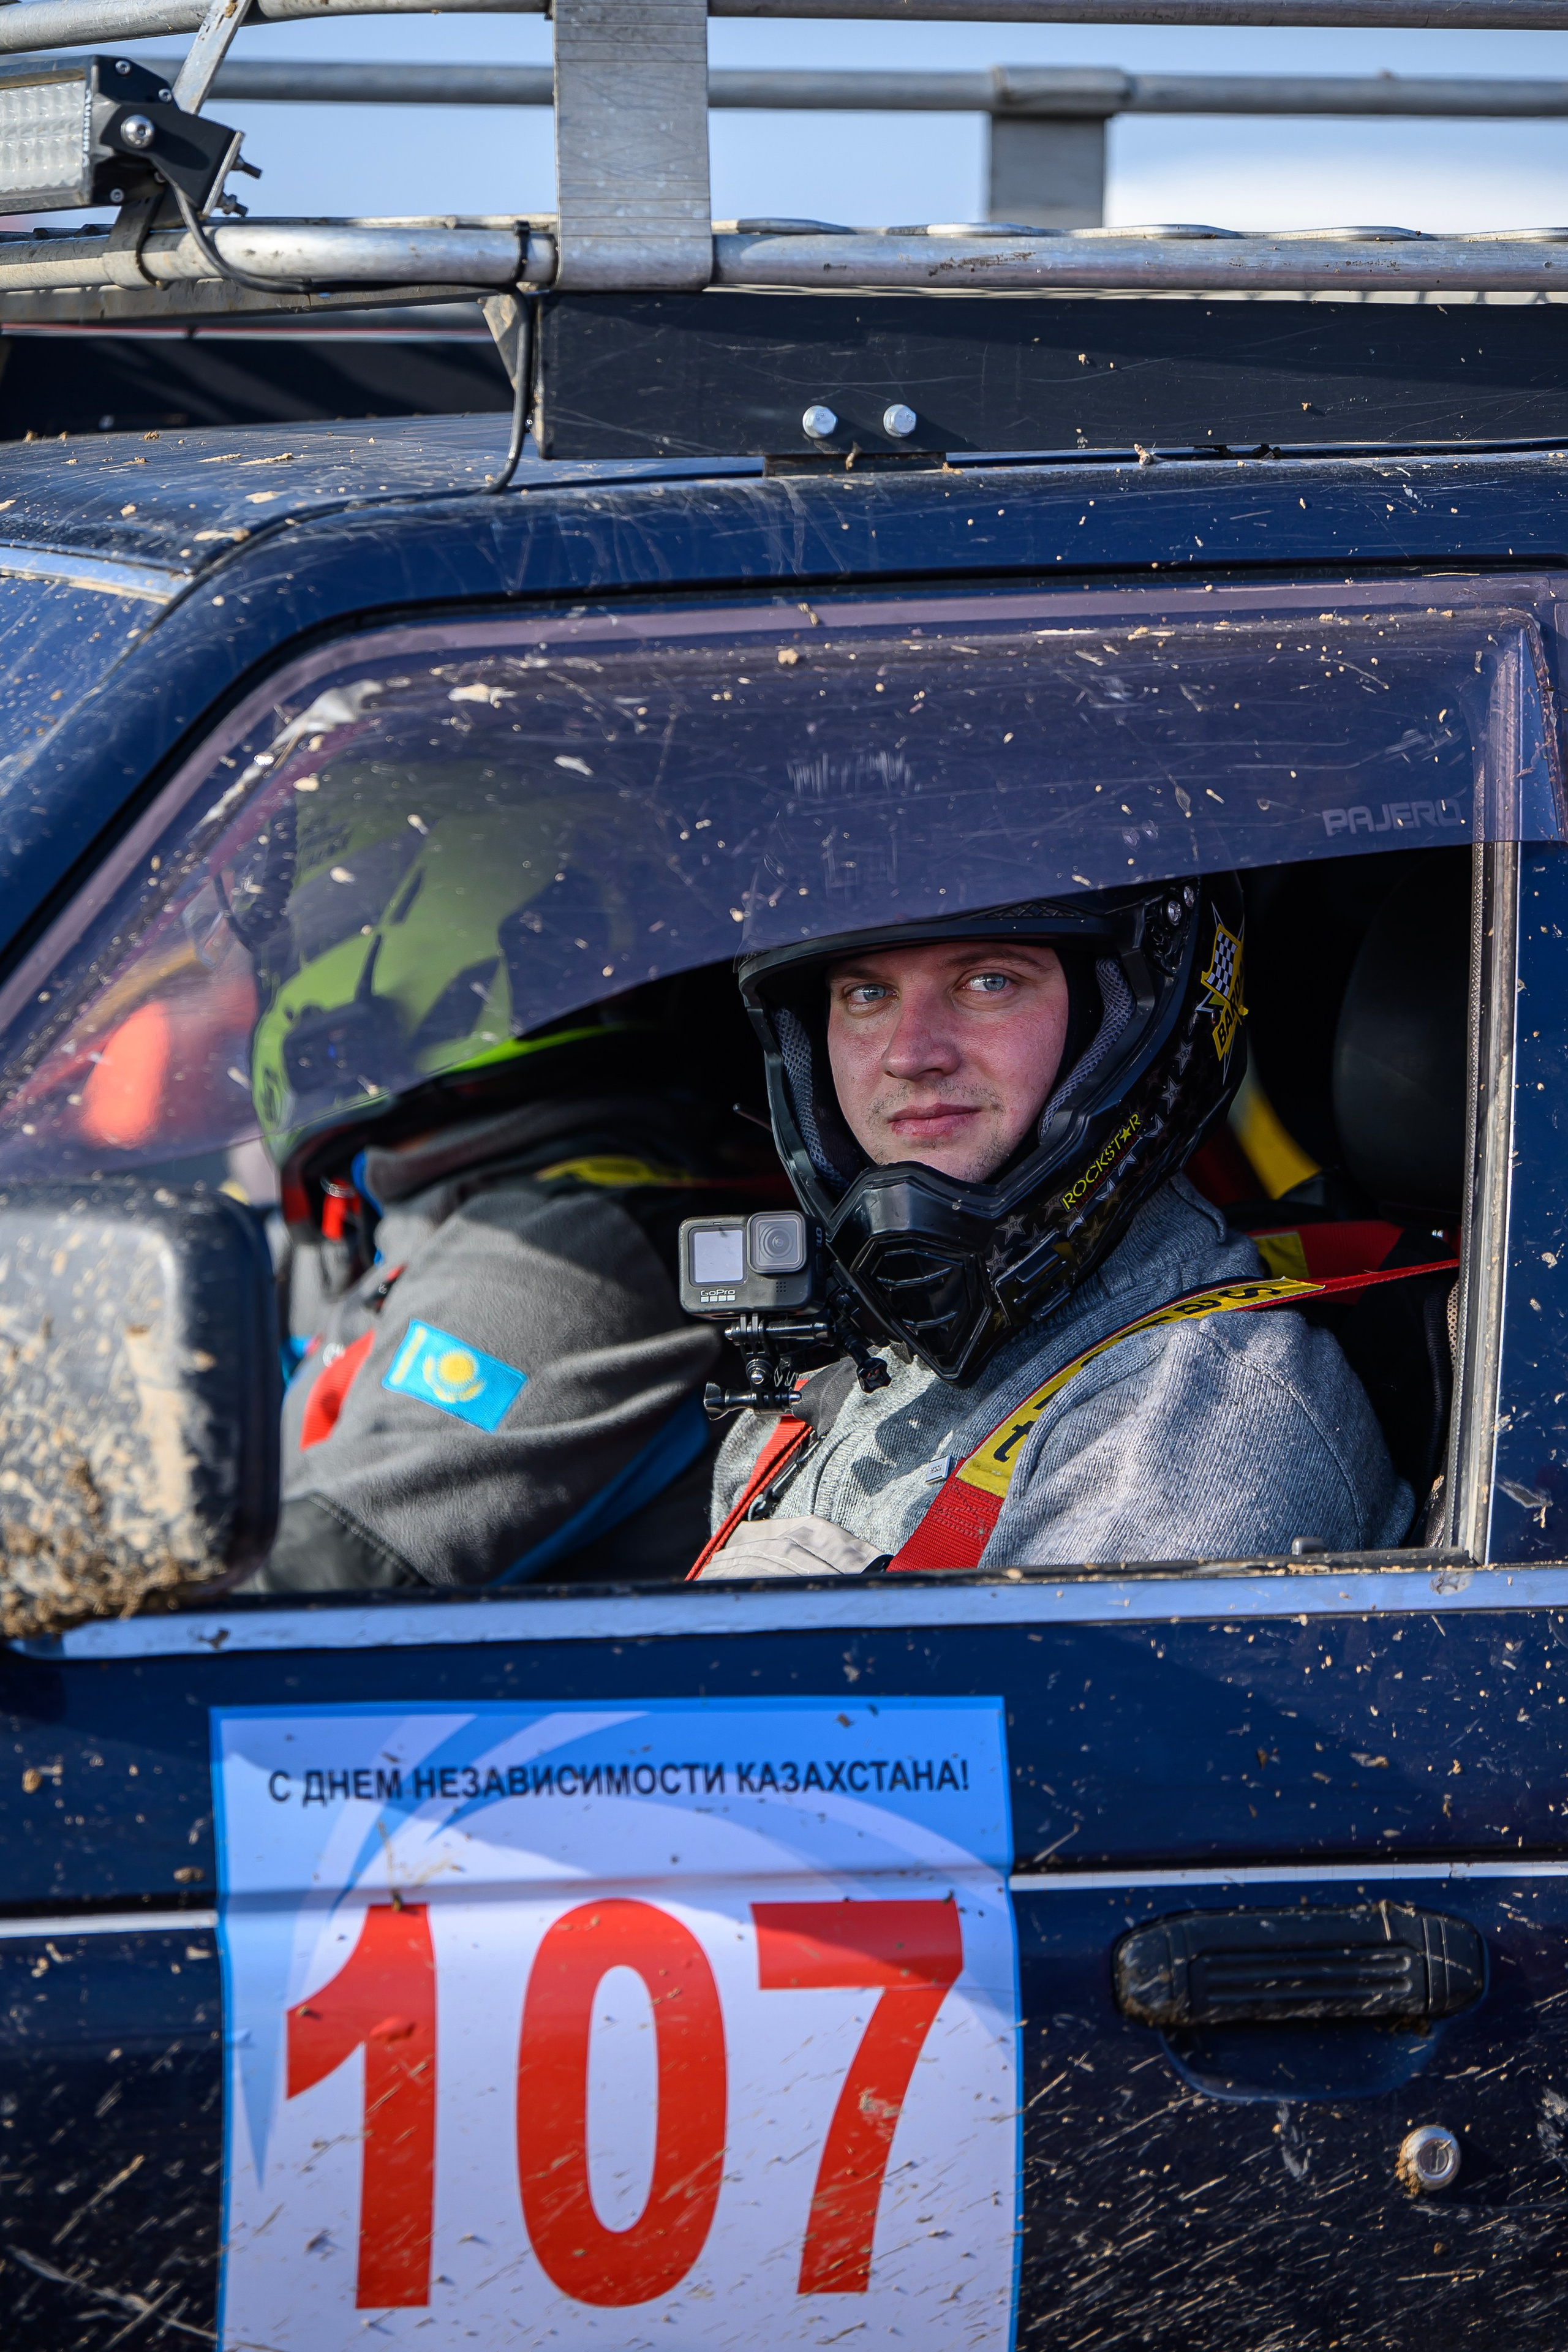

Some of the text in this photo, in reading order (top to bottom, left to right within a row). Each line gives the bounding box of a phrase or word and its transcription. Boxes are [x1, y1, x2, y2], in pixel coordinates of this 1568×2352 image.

[1322, 798, 1462, 837] PAJERO
[268, 1758, 969, 1807] С ДНЕМ НЕЗАВИСИМОСТИ КАЗАХСТАНА!
[286, 1897, 963, 2307] 107
